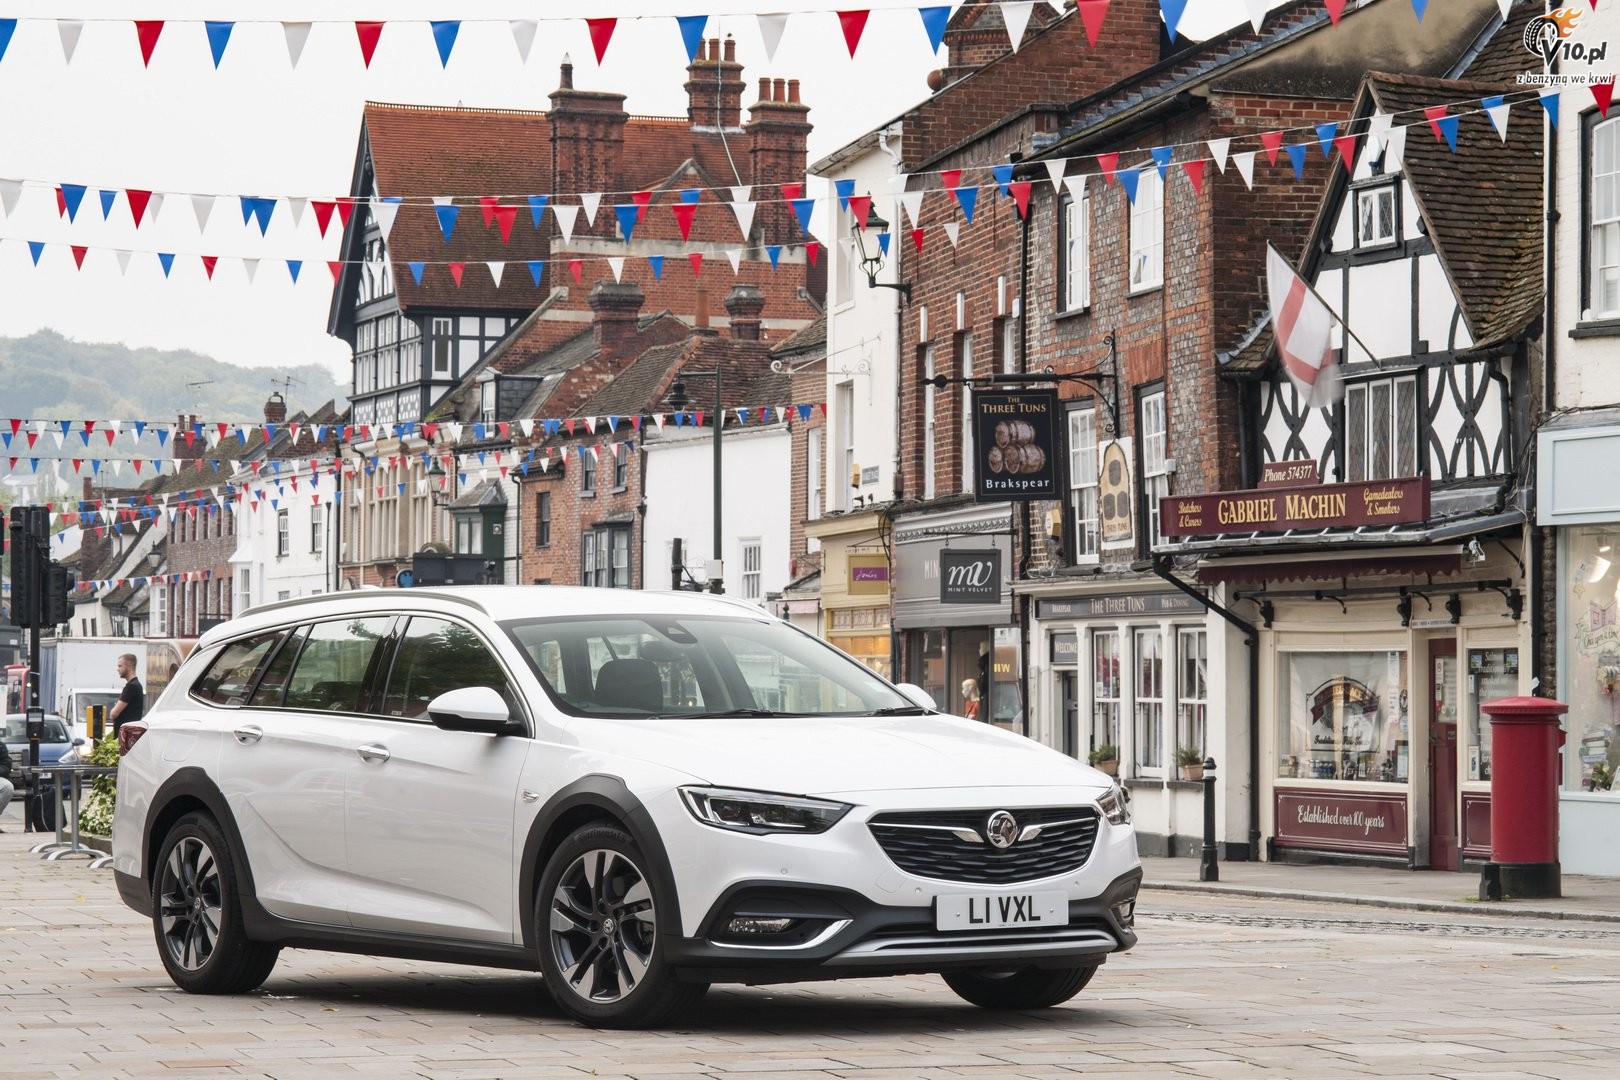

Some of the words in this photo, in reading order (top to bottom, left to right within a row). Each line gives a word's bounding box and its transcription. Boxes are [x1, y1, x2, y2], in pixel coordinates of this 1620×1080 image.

[981, 403, 1016, 413] THREE
[1018, 403, 1047, 412] TUNS
[1264, 467, 1286, 482] Phone
[1286, 465, 1312, 480] 574377
[985, 478, 1050, 490] Brakspear
[1363, 486, 1404, 505] Gamedealers
[1178, 501, 1202, 514] Butchers
[1218, 498, 1278, 525] GABRIEL
[1285, 493, 1347, 520] MACHIN
[1367, 506, 1373, 516] &
[1374, 501, 1401, 515] Smokers
[924, 560, 939, 579] MIN
[1090, 598, 1104, 615] THE
[1104, 597, 1126, 613] THREE
[1126, 596, 1145, 612] TUNS
[1054, 641, 1078, 654] WELCOME
[1297, 804, 1339, 824] Established
[1339, 813, 1353, 826] over
[1364, 816, 1385, 836] years
[998, 895, 1041, 923] VXL
